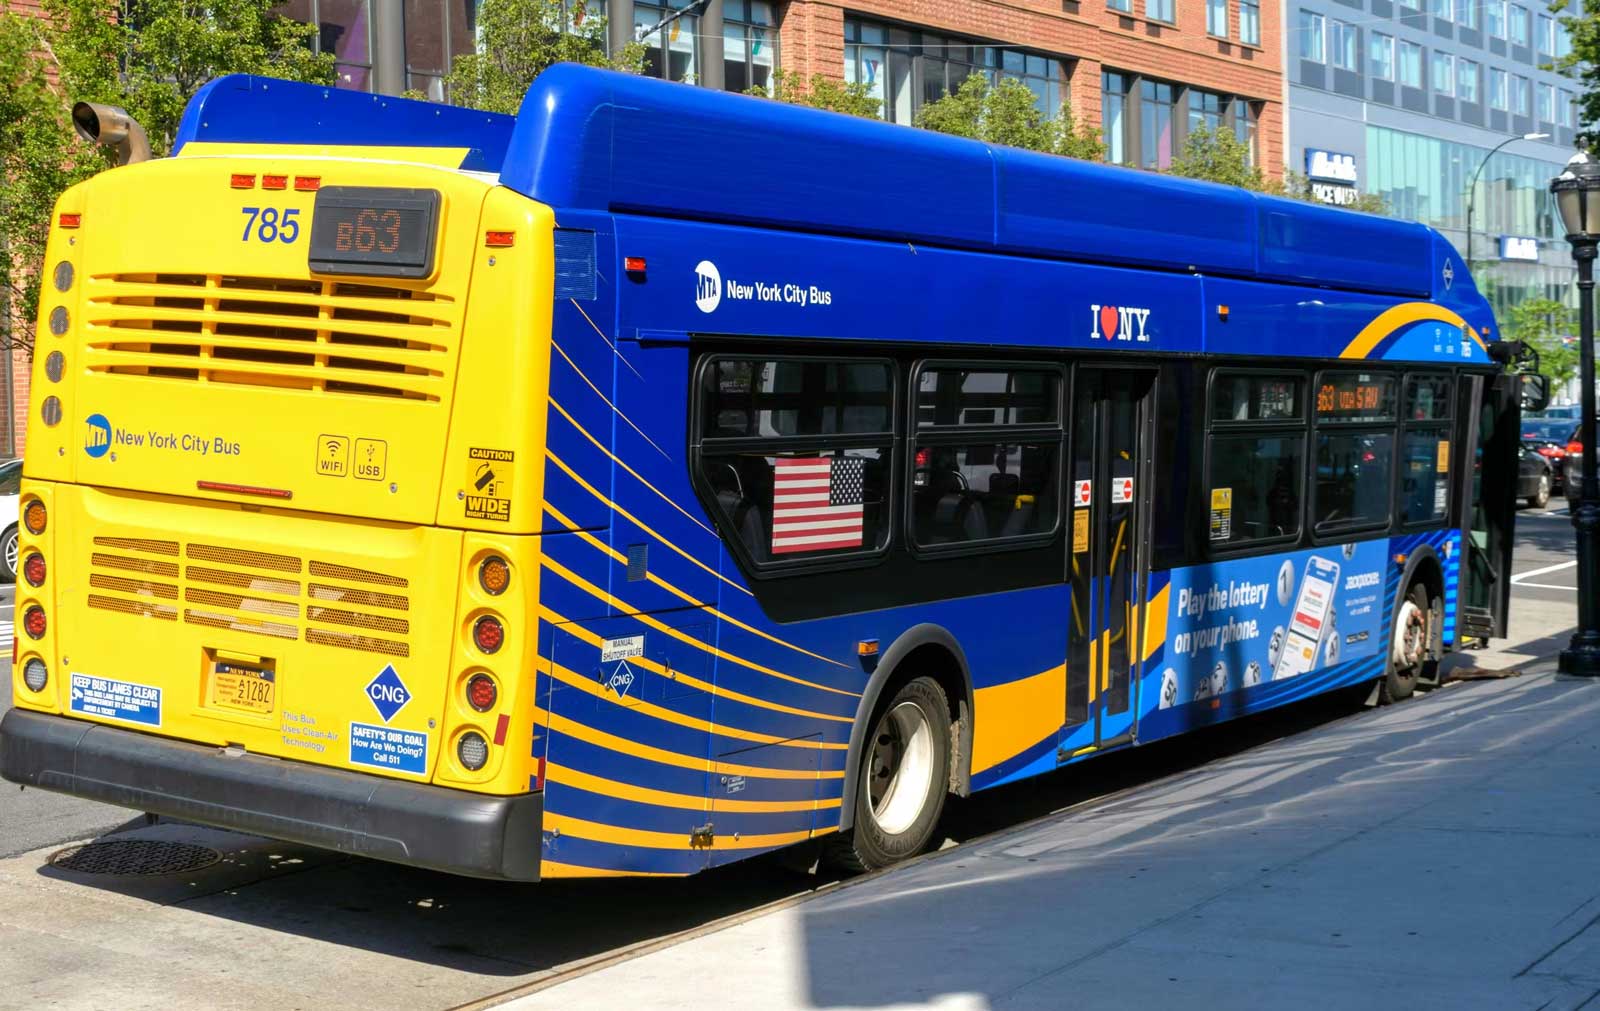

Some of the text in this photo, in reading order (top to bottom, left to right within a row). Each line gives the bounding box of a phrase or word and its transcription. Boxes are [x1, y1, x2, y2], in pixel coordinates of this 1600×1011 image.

[241, 207, 300, 244] 785
[335, 208, 401, 254] B63
[696, 271, 717, 302] MTA
[727, 280, 832, 307] New York City Bus
[115, 428, 241, 456] New York City Bus
[321, 459, 343, 472] WIFI
[470, 449, 513, 461] CAUTION
[358, 464, 380, 476] USB
[467, 496, 509, 514] WIDE
[1177, 580, 1270, 621] Play the lottery
[1174, 632, 1191, 655] on
[1191, 626, 1221, 658] your
[1220, 615, 1260, 652] phone.
[73, 676, 158, 701] KEEP BUS LANES CLEAR
[612, 673, 631, 687] CNG
[370, 683, 405, 704] CNG
[283, 711, 316, 725] This Bus
[281, 724, 301, 734] Uses
[353, 726, 425, 747] SAFETY'S OUR GOAL
[282, 735, 326, 752] Technology
[352, 737, 423, 758] How Are We Doing?
[373, 752, 401, 765] Call 511
